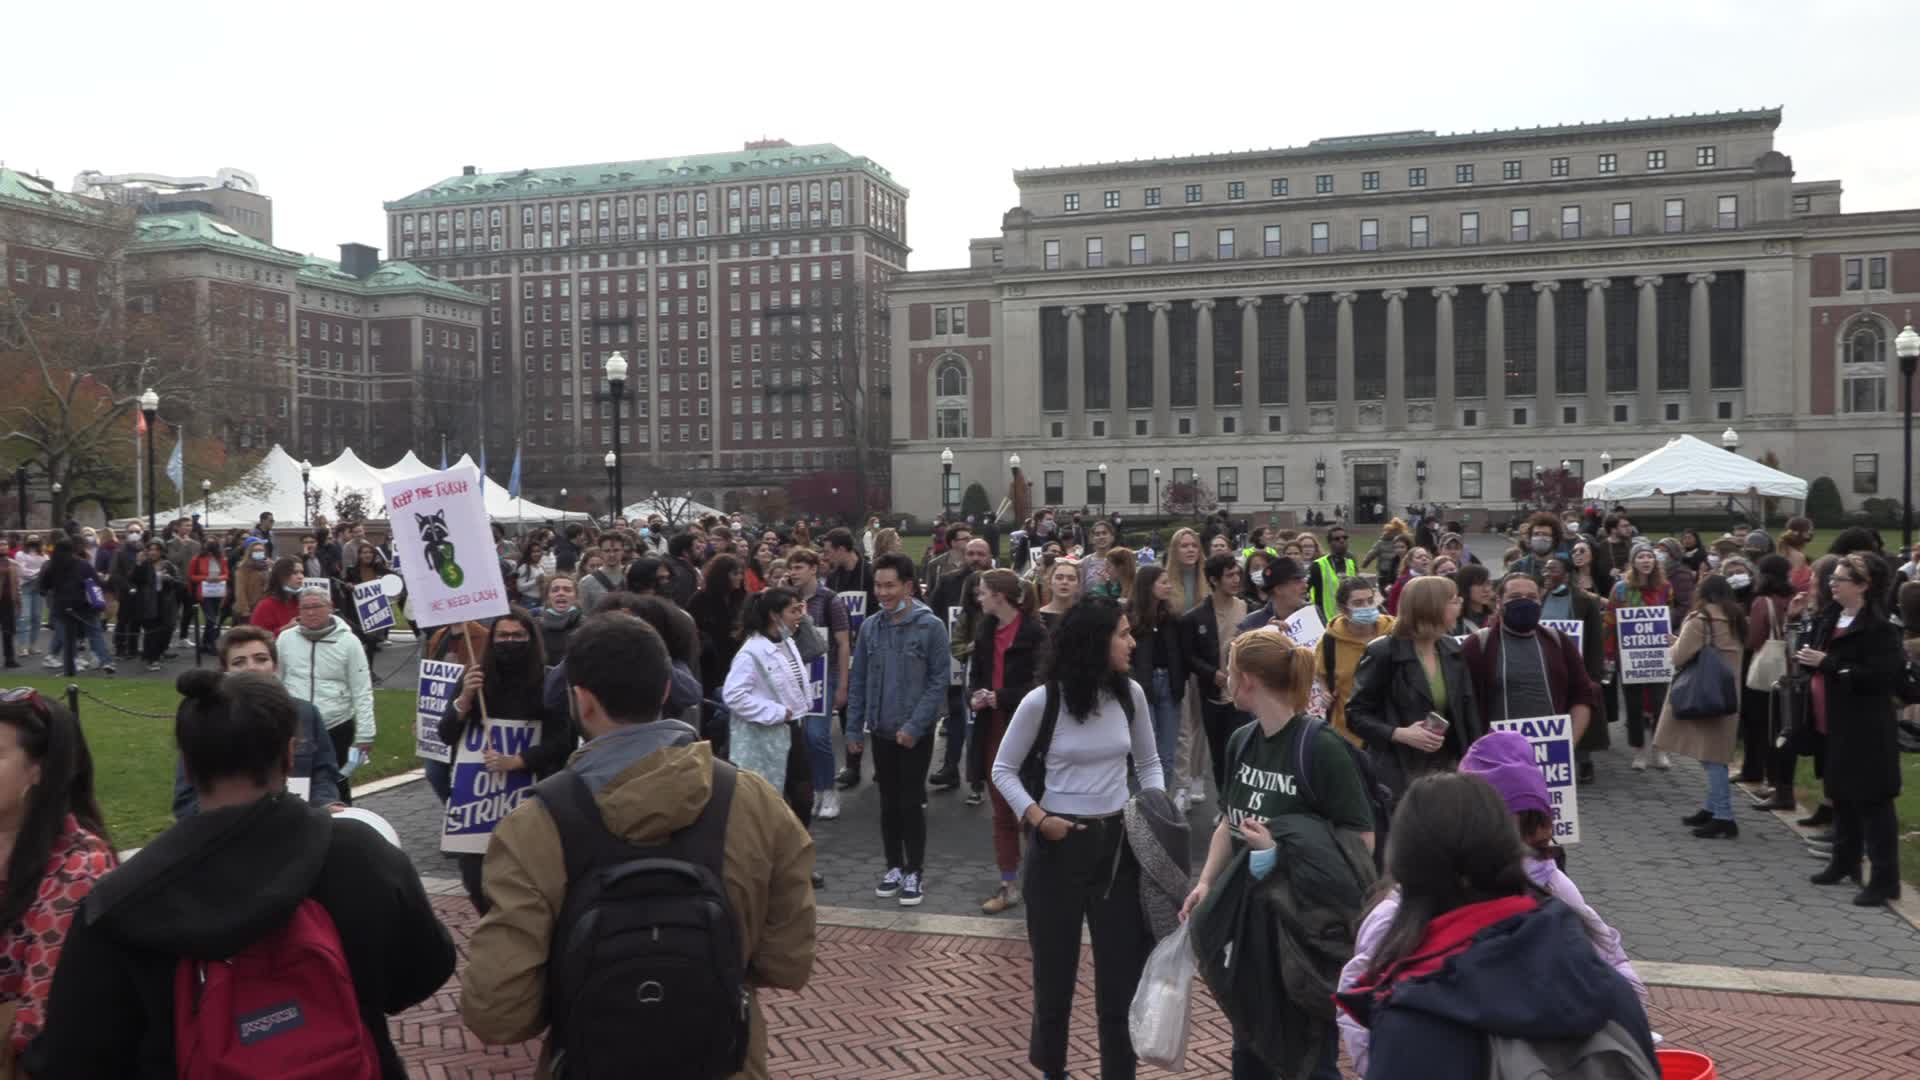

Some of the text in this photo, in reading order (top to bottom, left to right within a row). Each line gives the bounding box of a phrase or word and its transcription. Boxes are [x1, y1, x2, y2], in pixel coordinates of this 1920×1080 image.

[354, 584, 382, 600] UAW
[1621, 608, 1665, 620] UAW
[1634, 622, 1655, 634] ON
[1623, 634, 1669, 647] STRIKE
[424, 662, 461, 680] UAW
[1632, 660, 1664, 669] LABOR
[1625, 668, 1672, 679] PRACTICE
[430, 682, 447, 698] ON
[419, 695, 449, 713] STRIK
[465, 722, 535, 757] UAW
[473, 770, 507, 797] ON
[1247, 791, 1265, 811] IS
[446, 789, 530, 832] STRIKE
